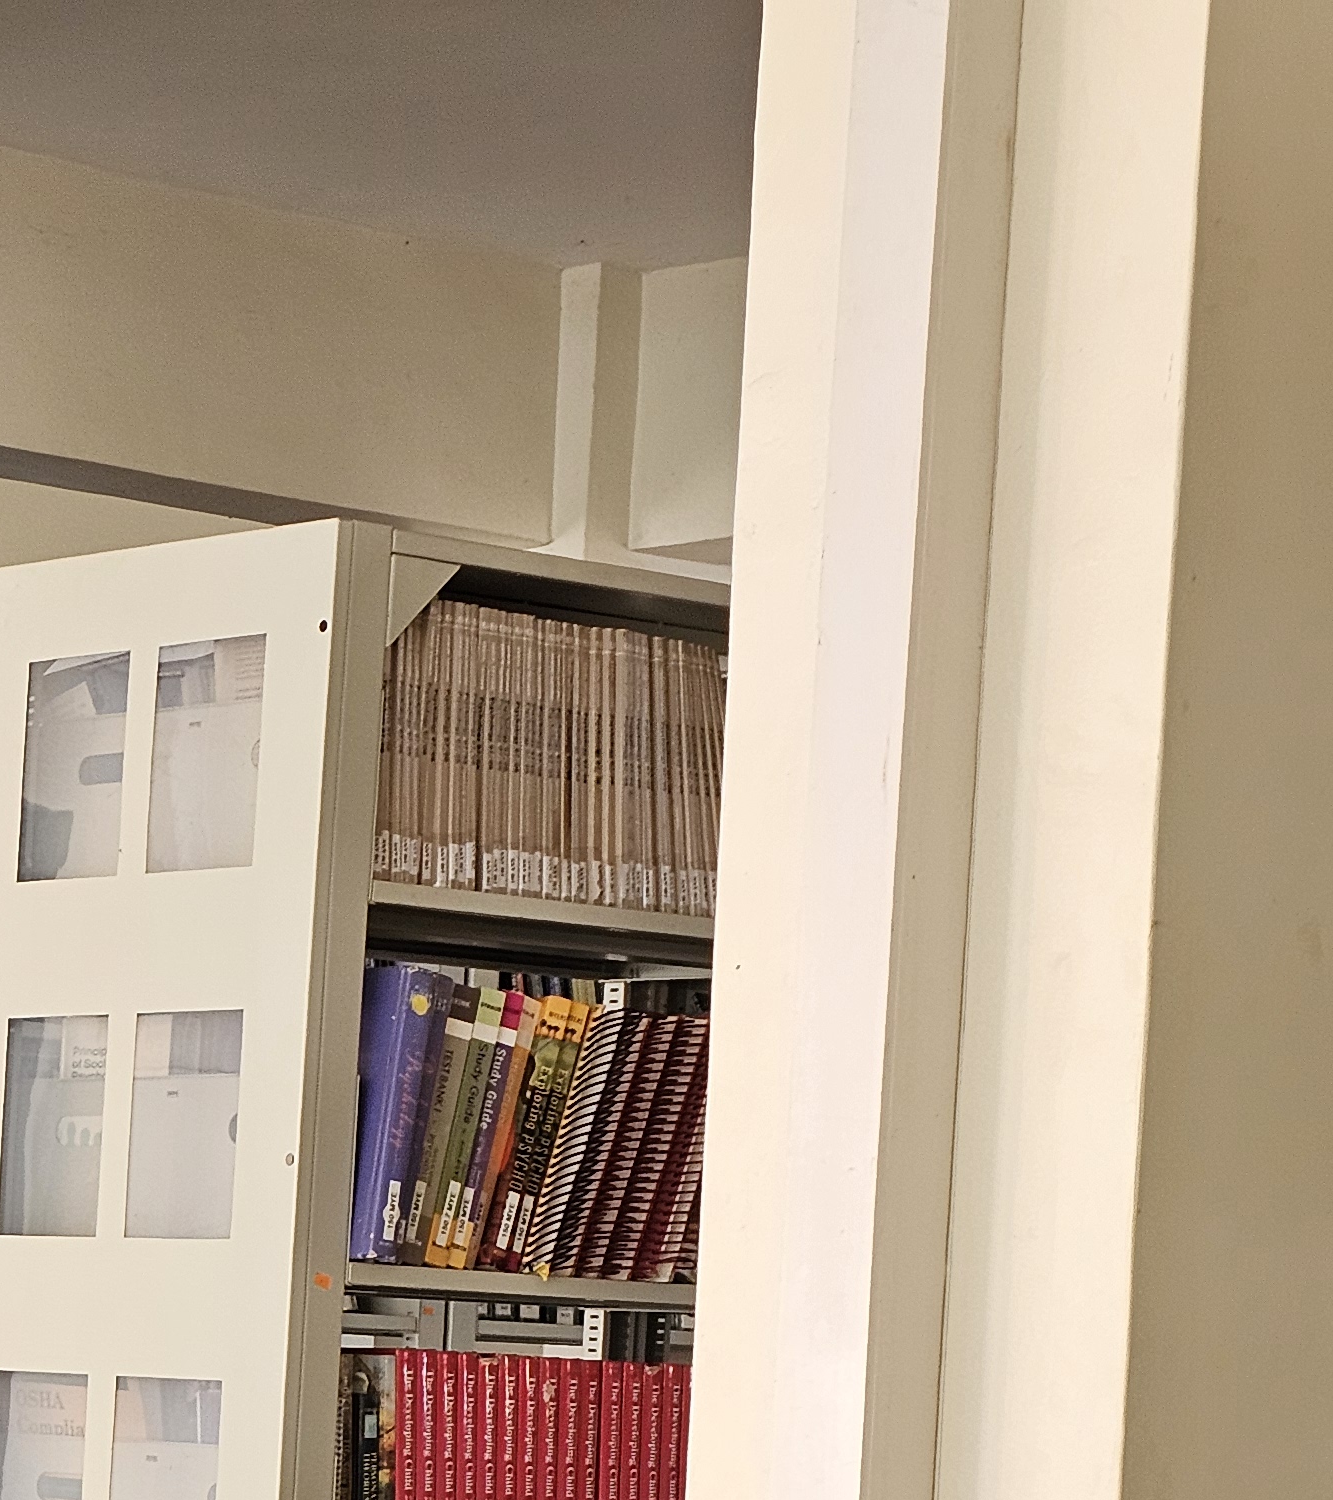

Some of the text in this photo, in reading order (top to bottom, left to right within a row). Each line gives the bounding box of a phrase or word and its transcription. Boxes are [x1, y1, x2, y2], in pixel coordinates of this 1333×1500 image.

[464, 1043, 489, 1125] Study Guide
[479, 1049, 506, 1130] Study Guide
[524, 1066, 551, 1131] Exploring
[541, 1069, 570, 1132] Exploring
[506, 1204, 515, 1221] MYE
[17, 1390, 65, 1410] OSHA
[403, 1370, 413, 1490] The Developing Child
[464, 1398, 474, 1460] Developing
[525, 1378, 536, 1496] The Developing Child
[585, 1381, 597, 1499] The Developing Child
[608, 1382, 620, 1499] The Developing Child
[629, 1405, 639, 1466] Developing
[629, 1469, 637, 1499] Child
